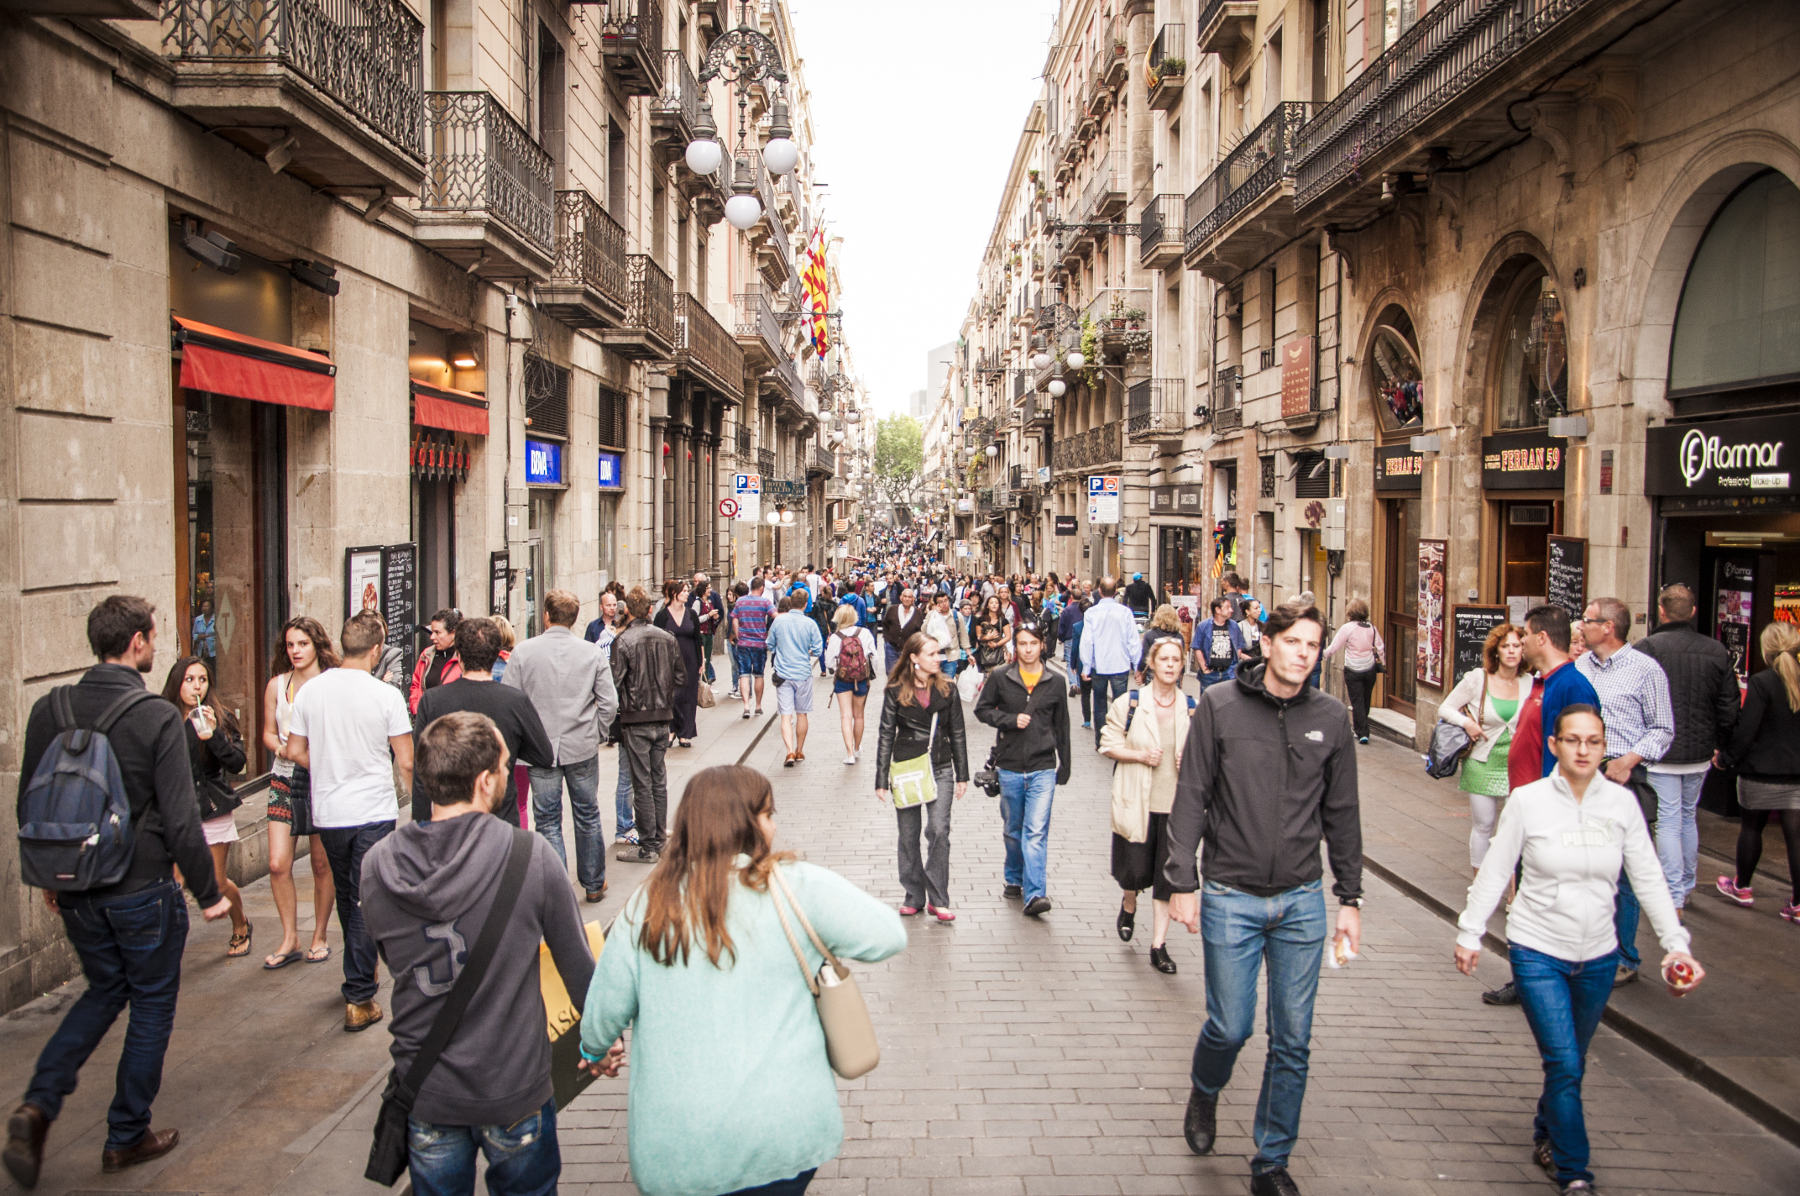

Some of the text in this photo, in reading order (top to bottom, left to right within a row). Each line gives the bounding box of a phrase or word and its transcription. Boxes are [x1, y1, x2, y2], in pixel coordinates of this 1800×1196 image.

[530, 449, 548, 476] BBVA
[1385, 456, 1413, 476] FERRAN
[1413, 456, 1422, 475] 59
[1501, 447, 1561, 472] FERRAN 59
[600, 460, 612, 481] BBVA
[1752, 474, 1781, 486] Make-Up
[1561, 829, 1606, 848] PUMA
